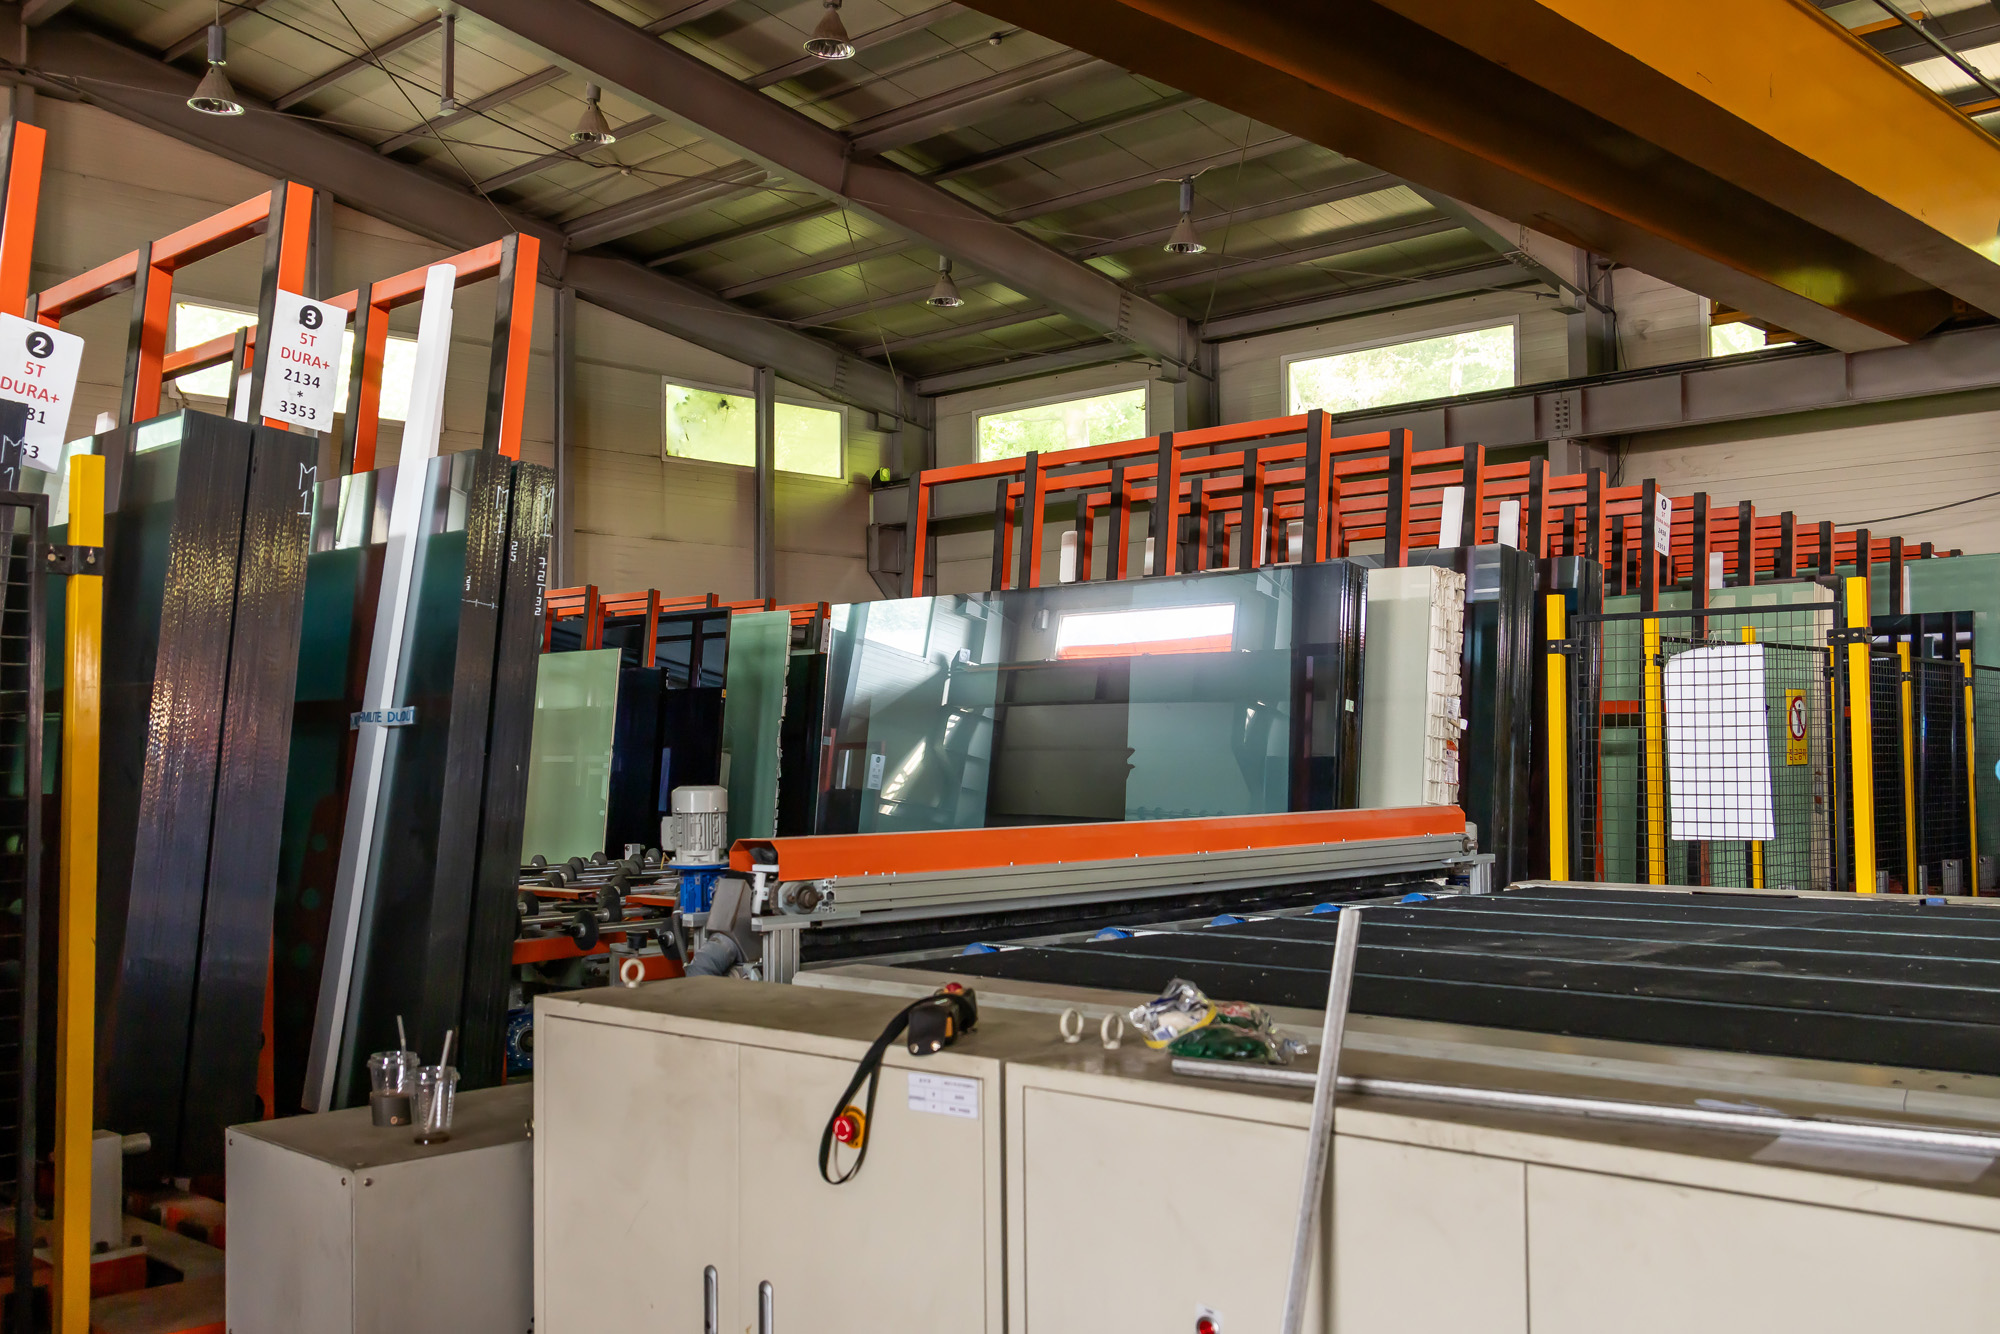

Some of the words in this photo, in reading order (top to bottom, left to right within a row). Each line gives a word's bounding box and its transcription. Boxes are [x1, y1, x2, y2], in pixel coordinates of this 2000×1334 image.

[303, 308, 319, 328] 3
[31, 335, 49, 357] 2
[299, 332, 317, 347] 5T
[281, 346, 330, 370] DURA+
[24, 361, 46, 378] 5T
[284, 368, 321, 389] 2134
[0, 376, 60, 404] DURA+
[279, 400, 316, 420] 3353
[298, 462, 318, 493] M
[297, 490, 312, 516] 1
